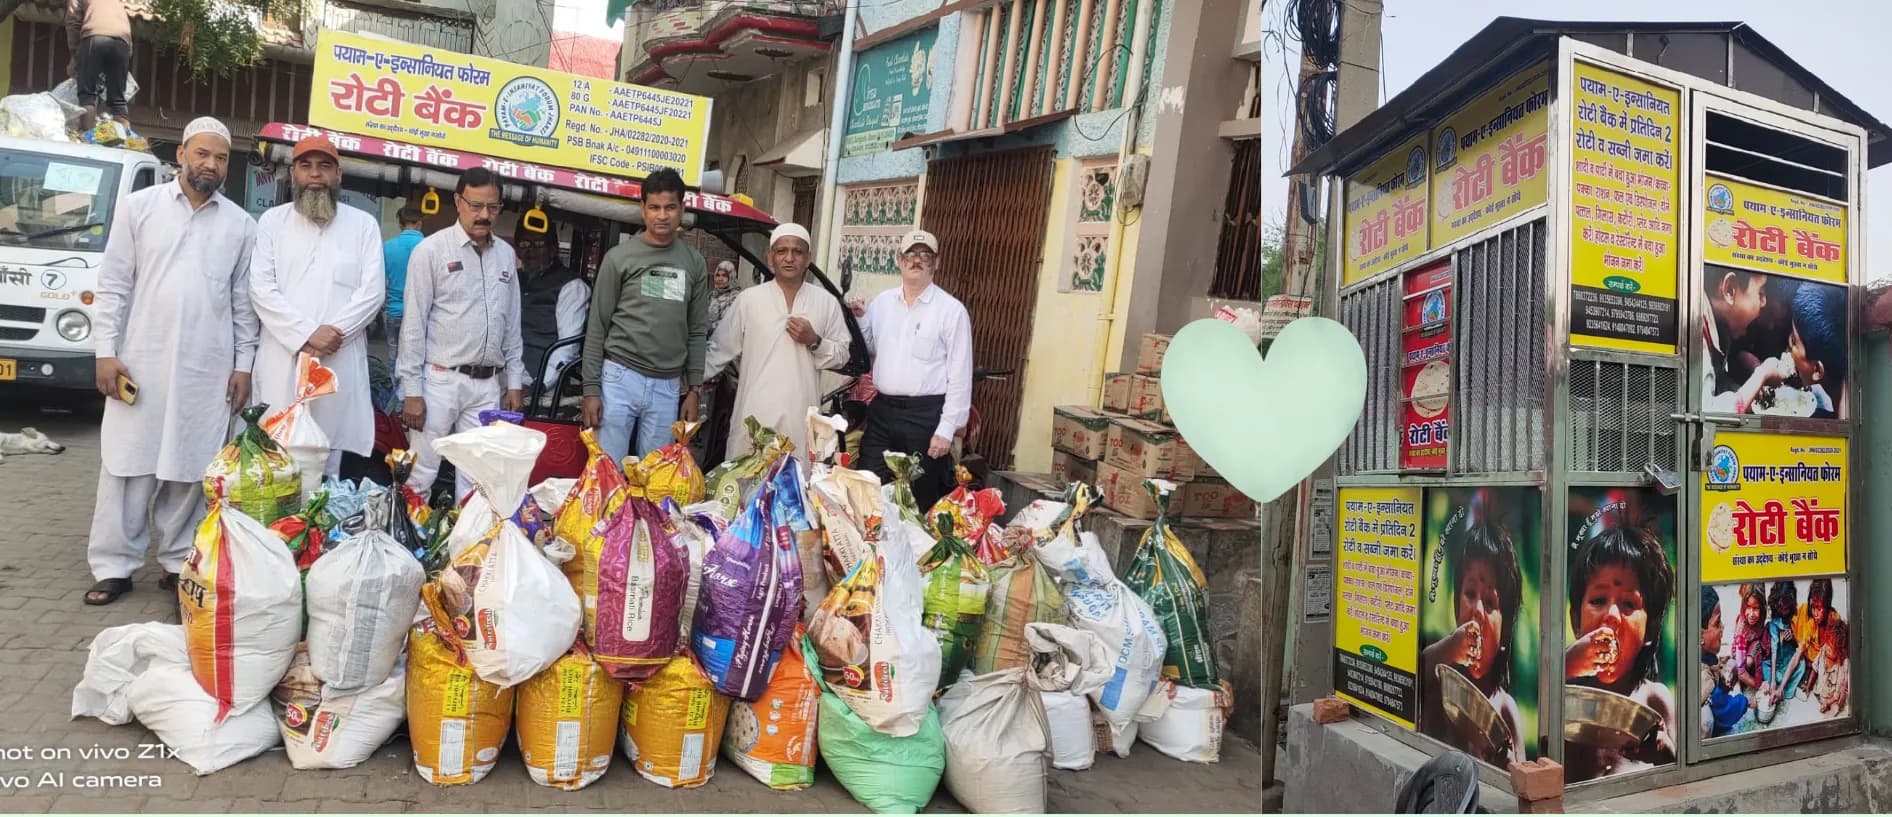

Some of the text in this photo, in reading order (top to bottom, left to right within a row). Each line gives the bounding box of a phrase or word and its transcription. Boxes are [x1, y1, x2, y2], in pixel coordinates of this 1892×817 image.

[458, 63, 491, 86] फोरम
[573, 80, 581, 88] 12
[584, 81, 590, 90] A
[330, 73, 487, 129] रोटी बैंक
[571, 91, 580, 100] 80
[583, 93, 590, 102] G
[569, 104, 588, 114] PAN
[1578, 99, 1597, 123] रोटी
[1630, 114, 1662, 140] प्रतिदिन
[1665, 126, 1672, 143] 2
[567, 135, 584, 147] PSB
[1576, 128, 1595, 151] रोटी
[1598, 138, 1604, 152] व
[1608, 139, 1631, 160] सब्जी
[1634, 147, 1653, 165] जमा
[590, 154, 608, 166] IFSC
[609, 157, 630, 169] Code
[1452, 133, 1547, 211] रोटी बैंक
[382, 141, 423, 162] रोटी
[424, 148, 460, 168] बैंक
[523, 164, 555, 184] बैंक
[702, 193, 733, 213] बैंक
[1360, 208, 1390, 256] रोटी
[1392, 194, 1426, 238] बैंक
[1732, 220, 1841, 262] रोटी बैंक
[0, 265, 32, 286] ाँसी
[46, 273, 58, 287] 7
[1409, 423, 1432, 446] रोटी
[1820, 461, 1841, 481] फोरम
[1380, 519, 1407, 537] प्रतिदिन
[1409, 523, 1415, 537] 2
[1732, 498, 1841, 546] रोटी बैंक
[1383, 545, 1398, 558] जमा
[627, 613, 636, 632] Rice
